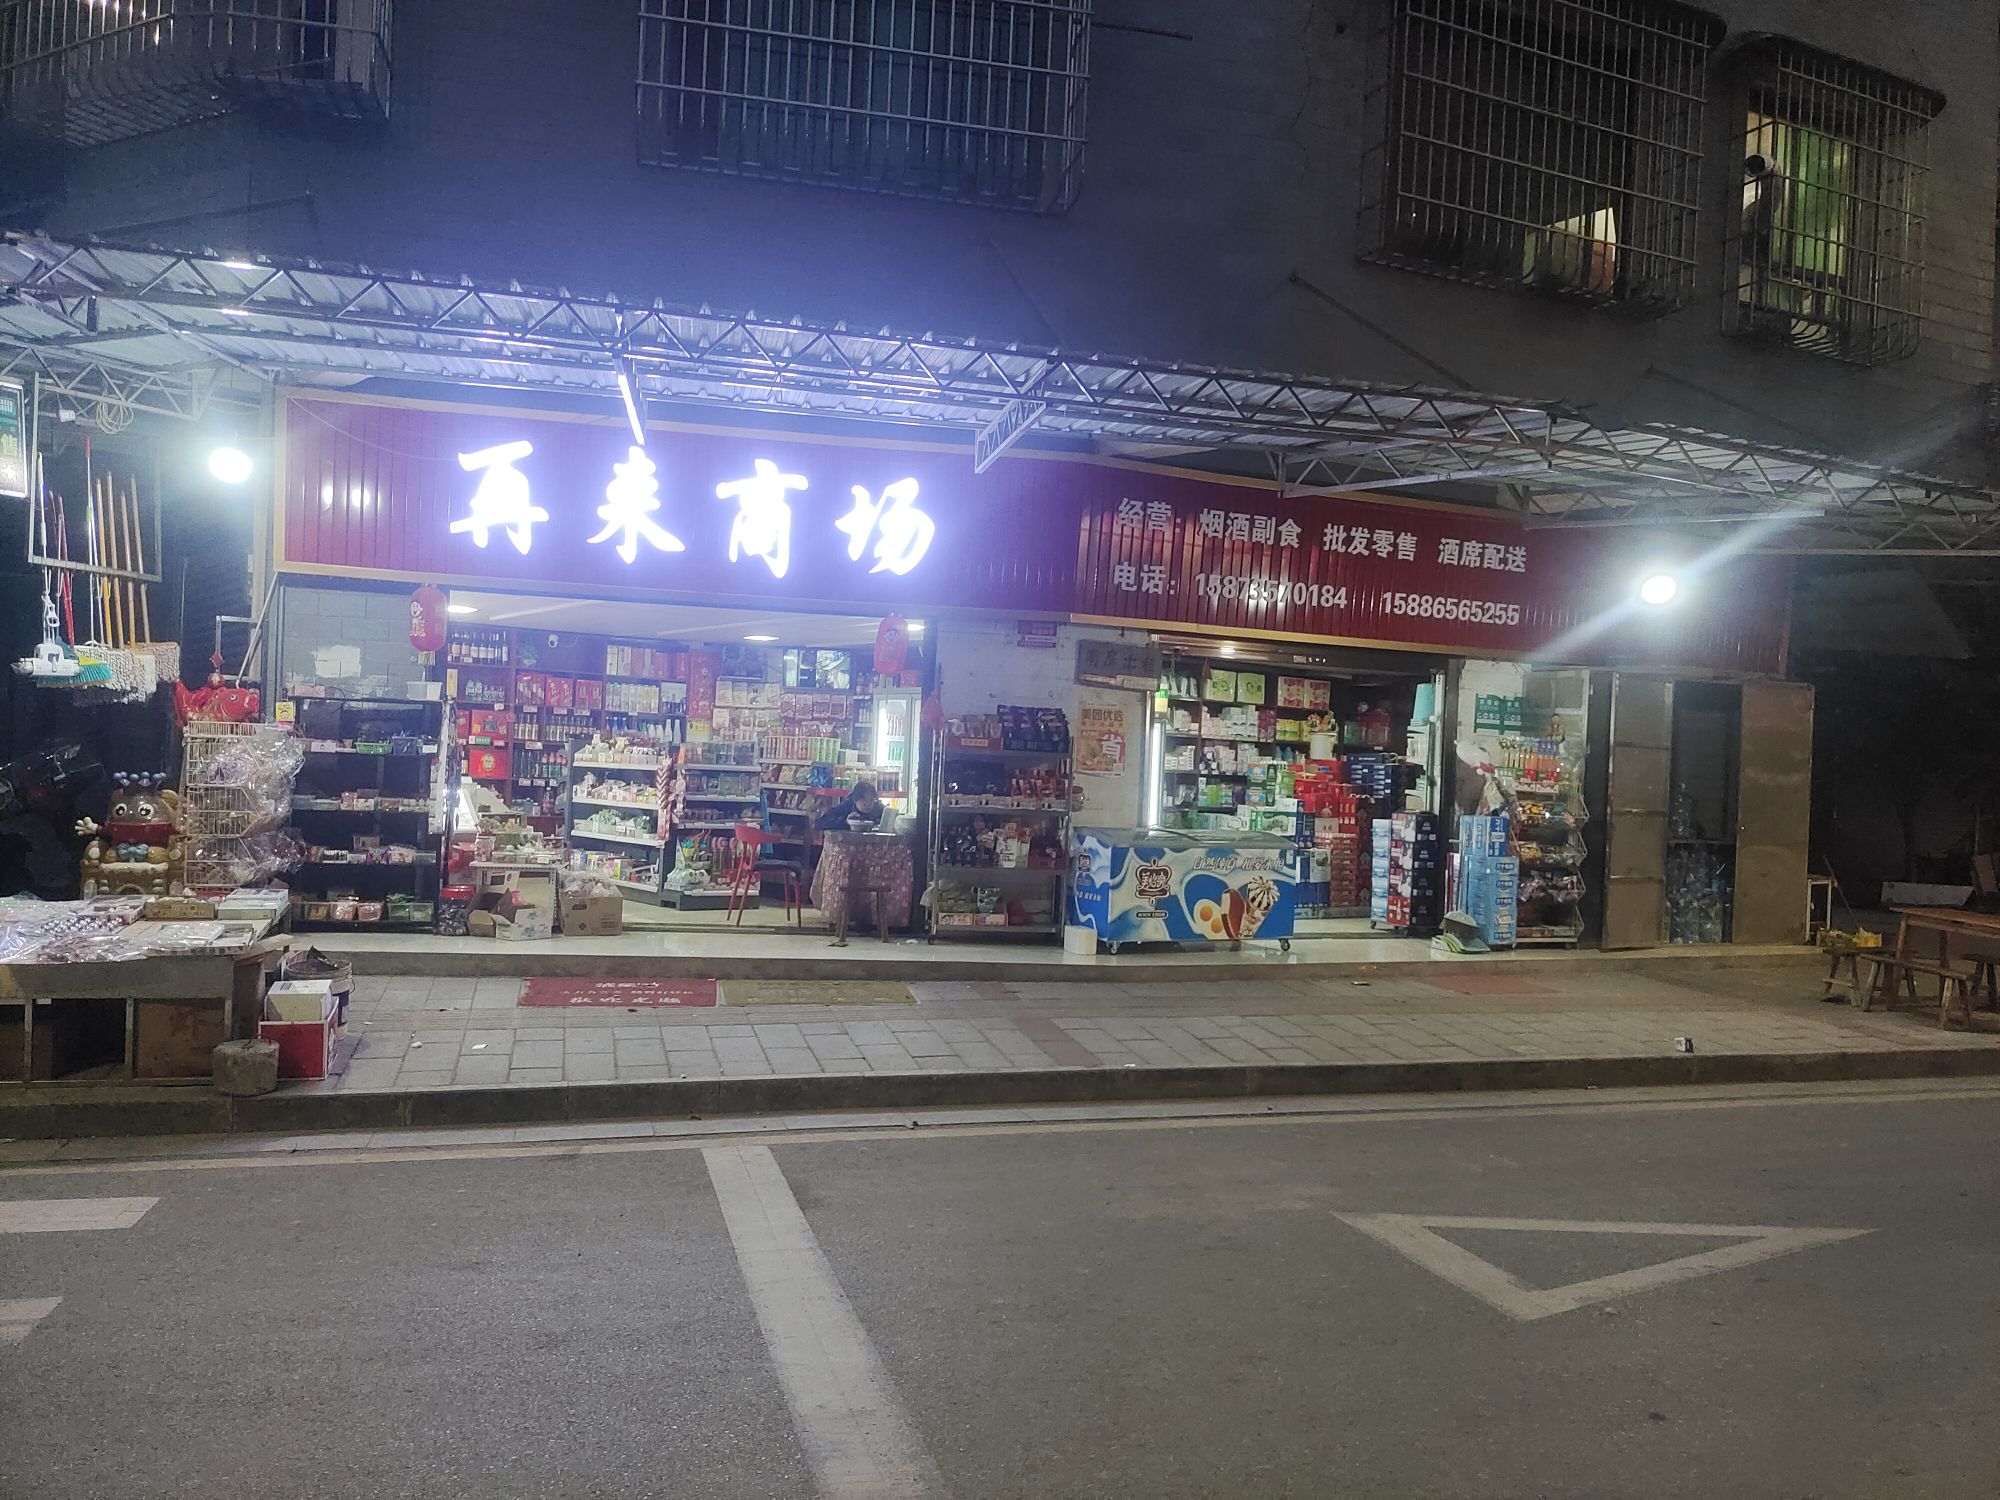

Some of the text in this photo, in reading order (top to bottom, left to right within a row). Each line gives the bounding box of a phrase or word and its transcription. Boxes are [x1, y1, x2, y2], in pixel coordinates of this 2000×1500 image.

[450, 440, 936, 579] 再来商场
[1200, 508, 1302, 548] 烟酒副食
[1323, 523, 1418, 562] 批发零售
[1437, 537, 1527, 572] 酒席配送
[1382, 591, 1520, 626] 15886565255
[1081, 708, 1124, 722] 美团优选
